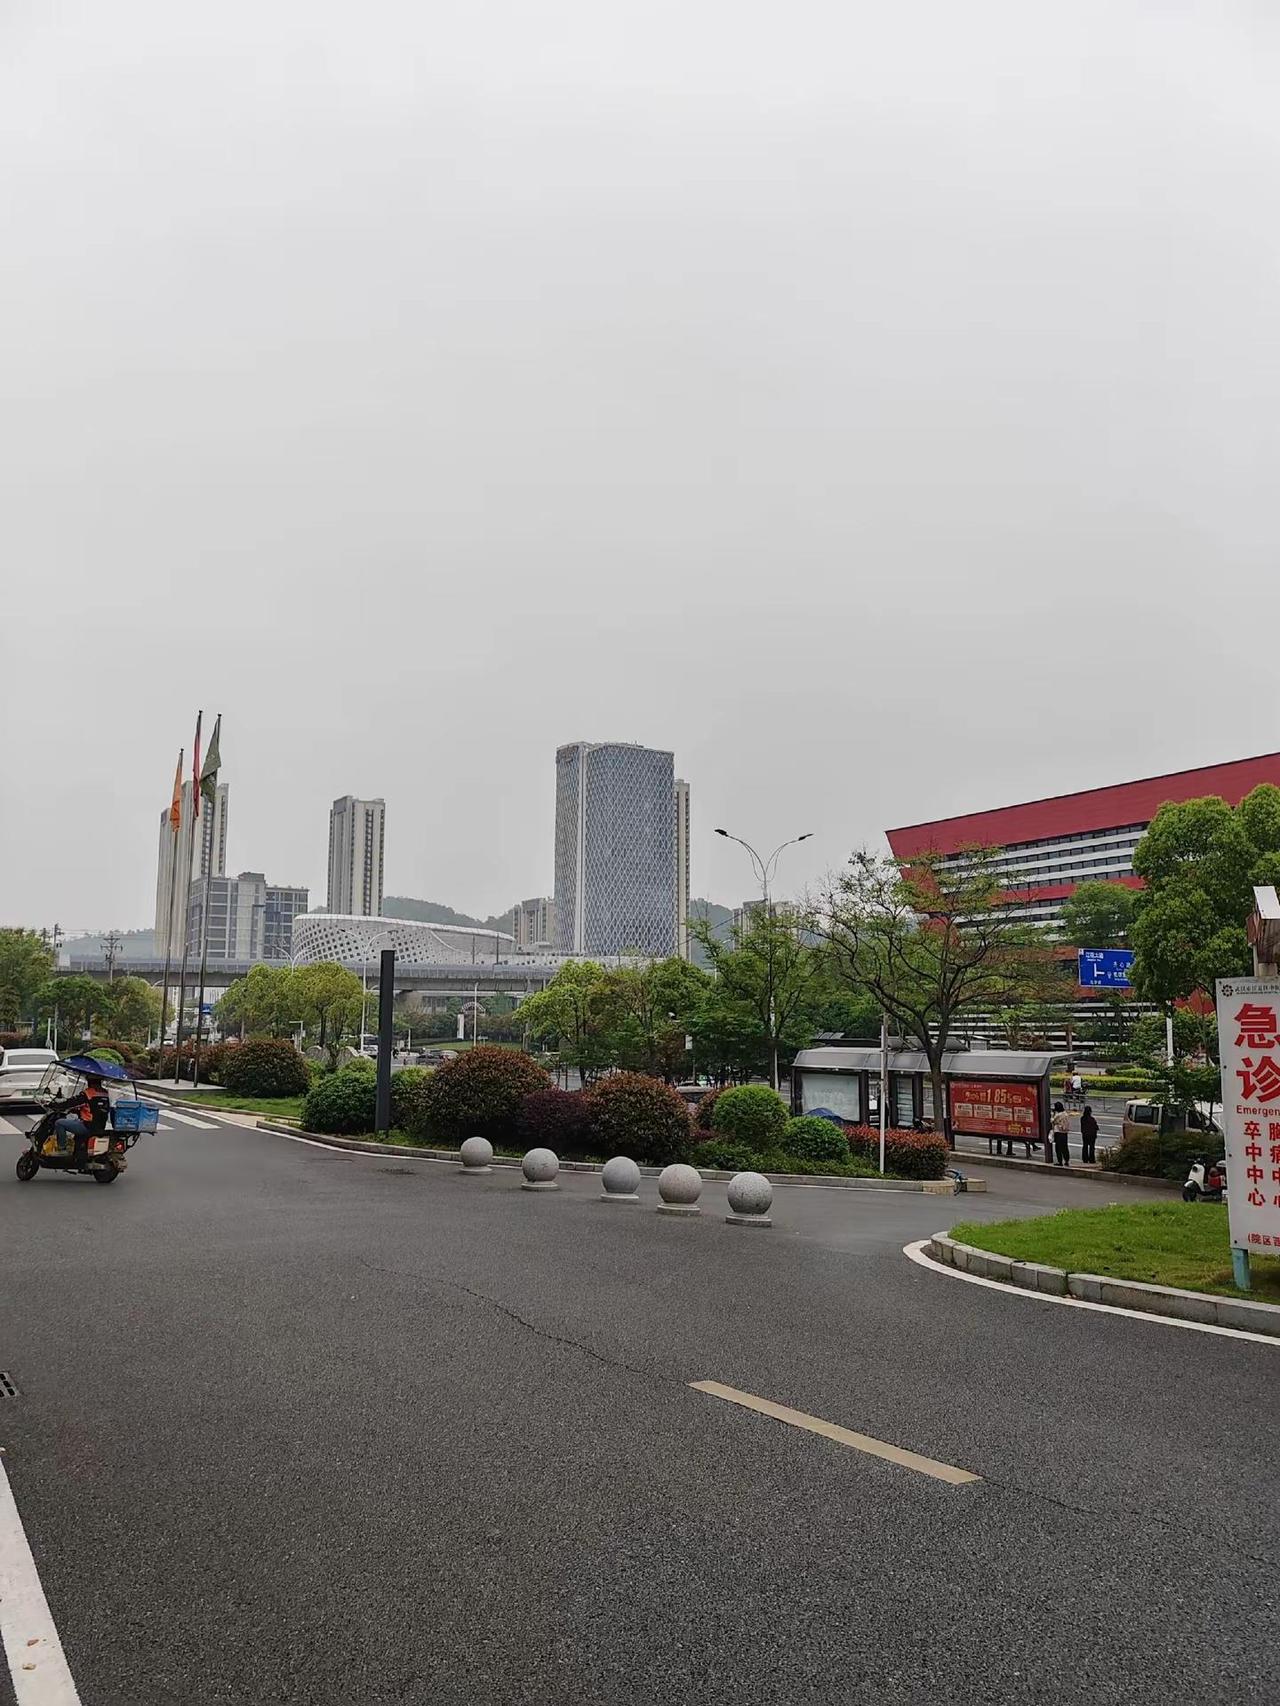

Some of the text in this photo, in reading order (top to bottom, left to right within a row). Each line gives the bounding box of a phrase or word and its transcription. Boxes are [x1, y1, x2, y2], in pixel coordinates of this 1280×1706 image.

[1234, 1003, 1280, 1103] 急诊
[1243, 1120, 1266, 1206] 卒中中心
